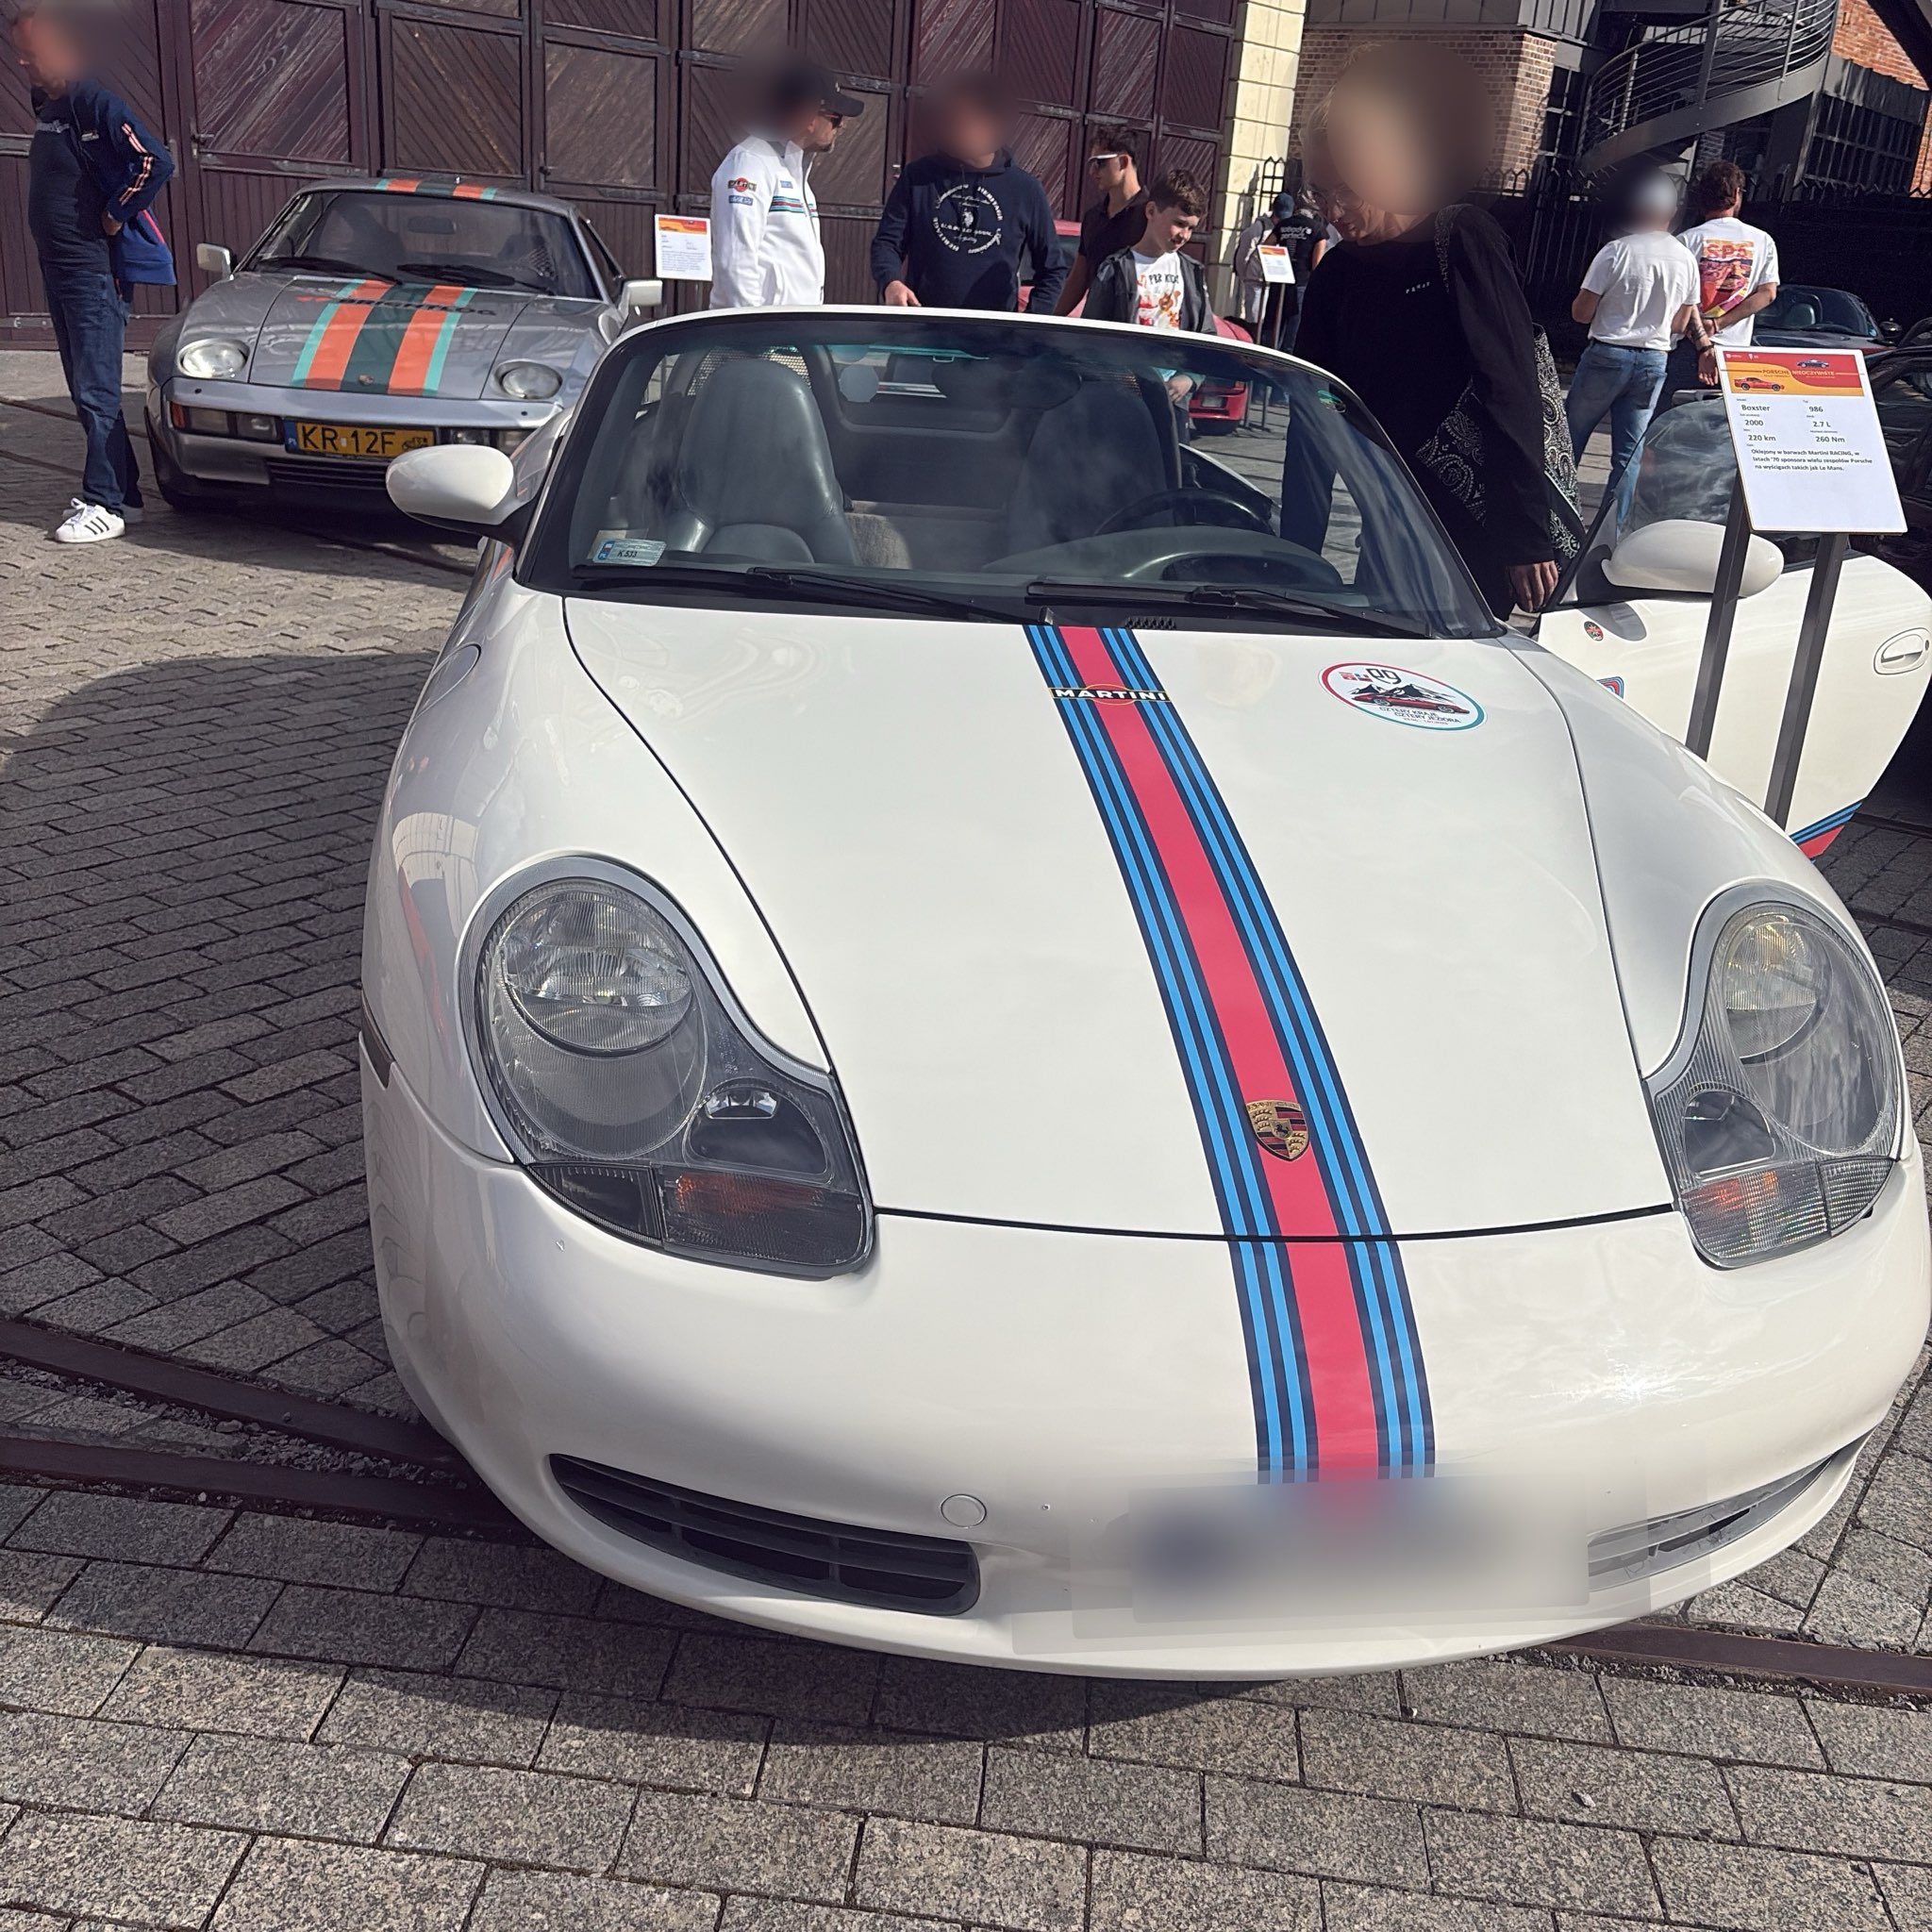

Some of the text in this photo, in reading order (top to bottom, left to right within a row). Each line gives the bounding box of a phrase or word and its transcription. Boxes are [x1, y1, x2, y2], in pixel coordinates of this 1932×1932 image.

[1740, 404, 1771, 412] Boxster
[301, 425, 395, 454] KR 12F
[1055, 689, 1167, 701] MARTINI
[1379, 707, 1411, 715] CZTERY
